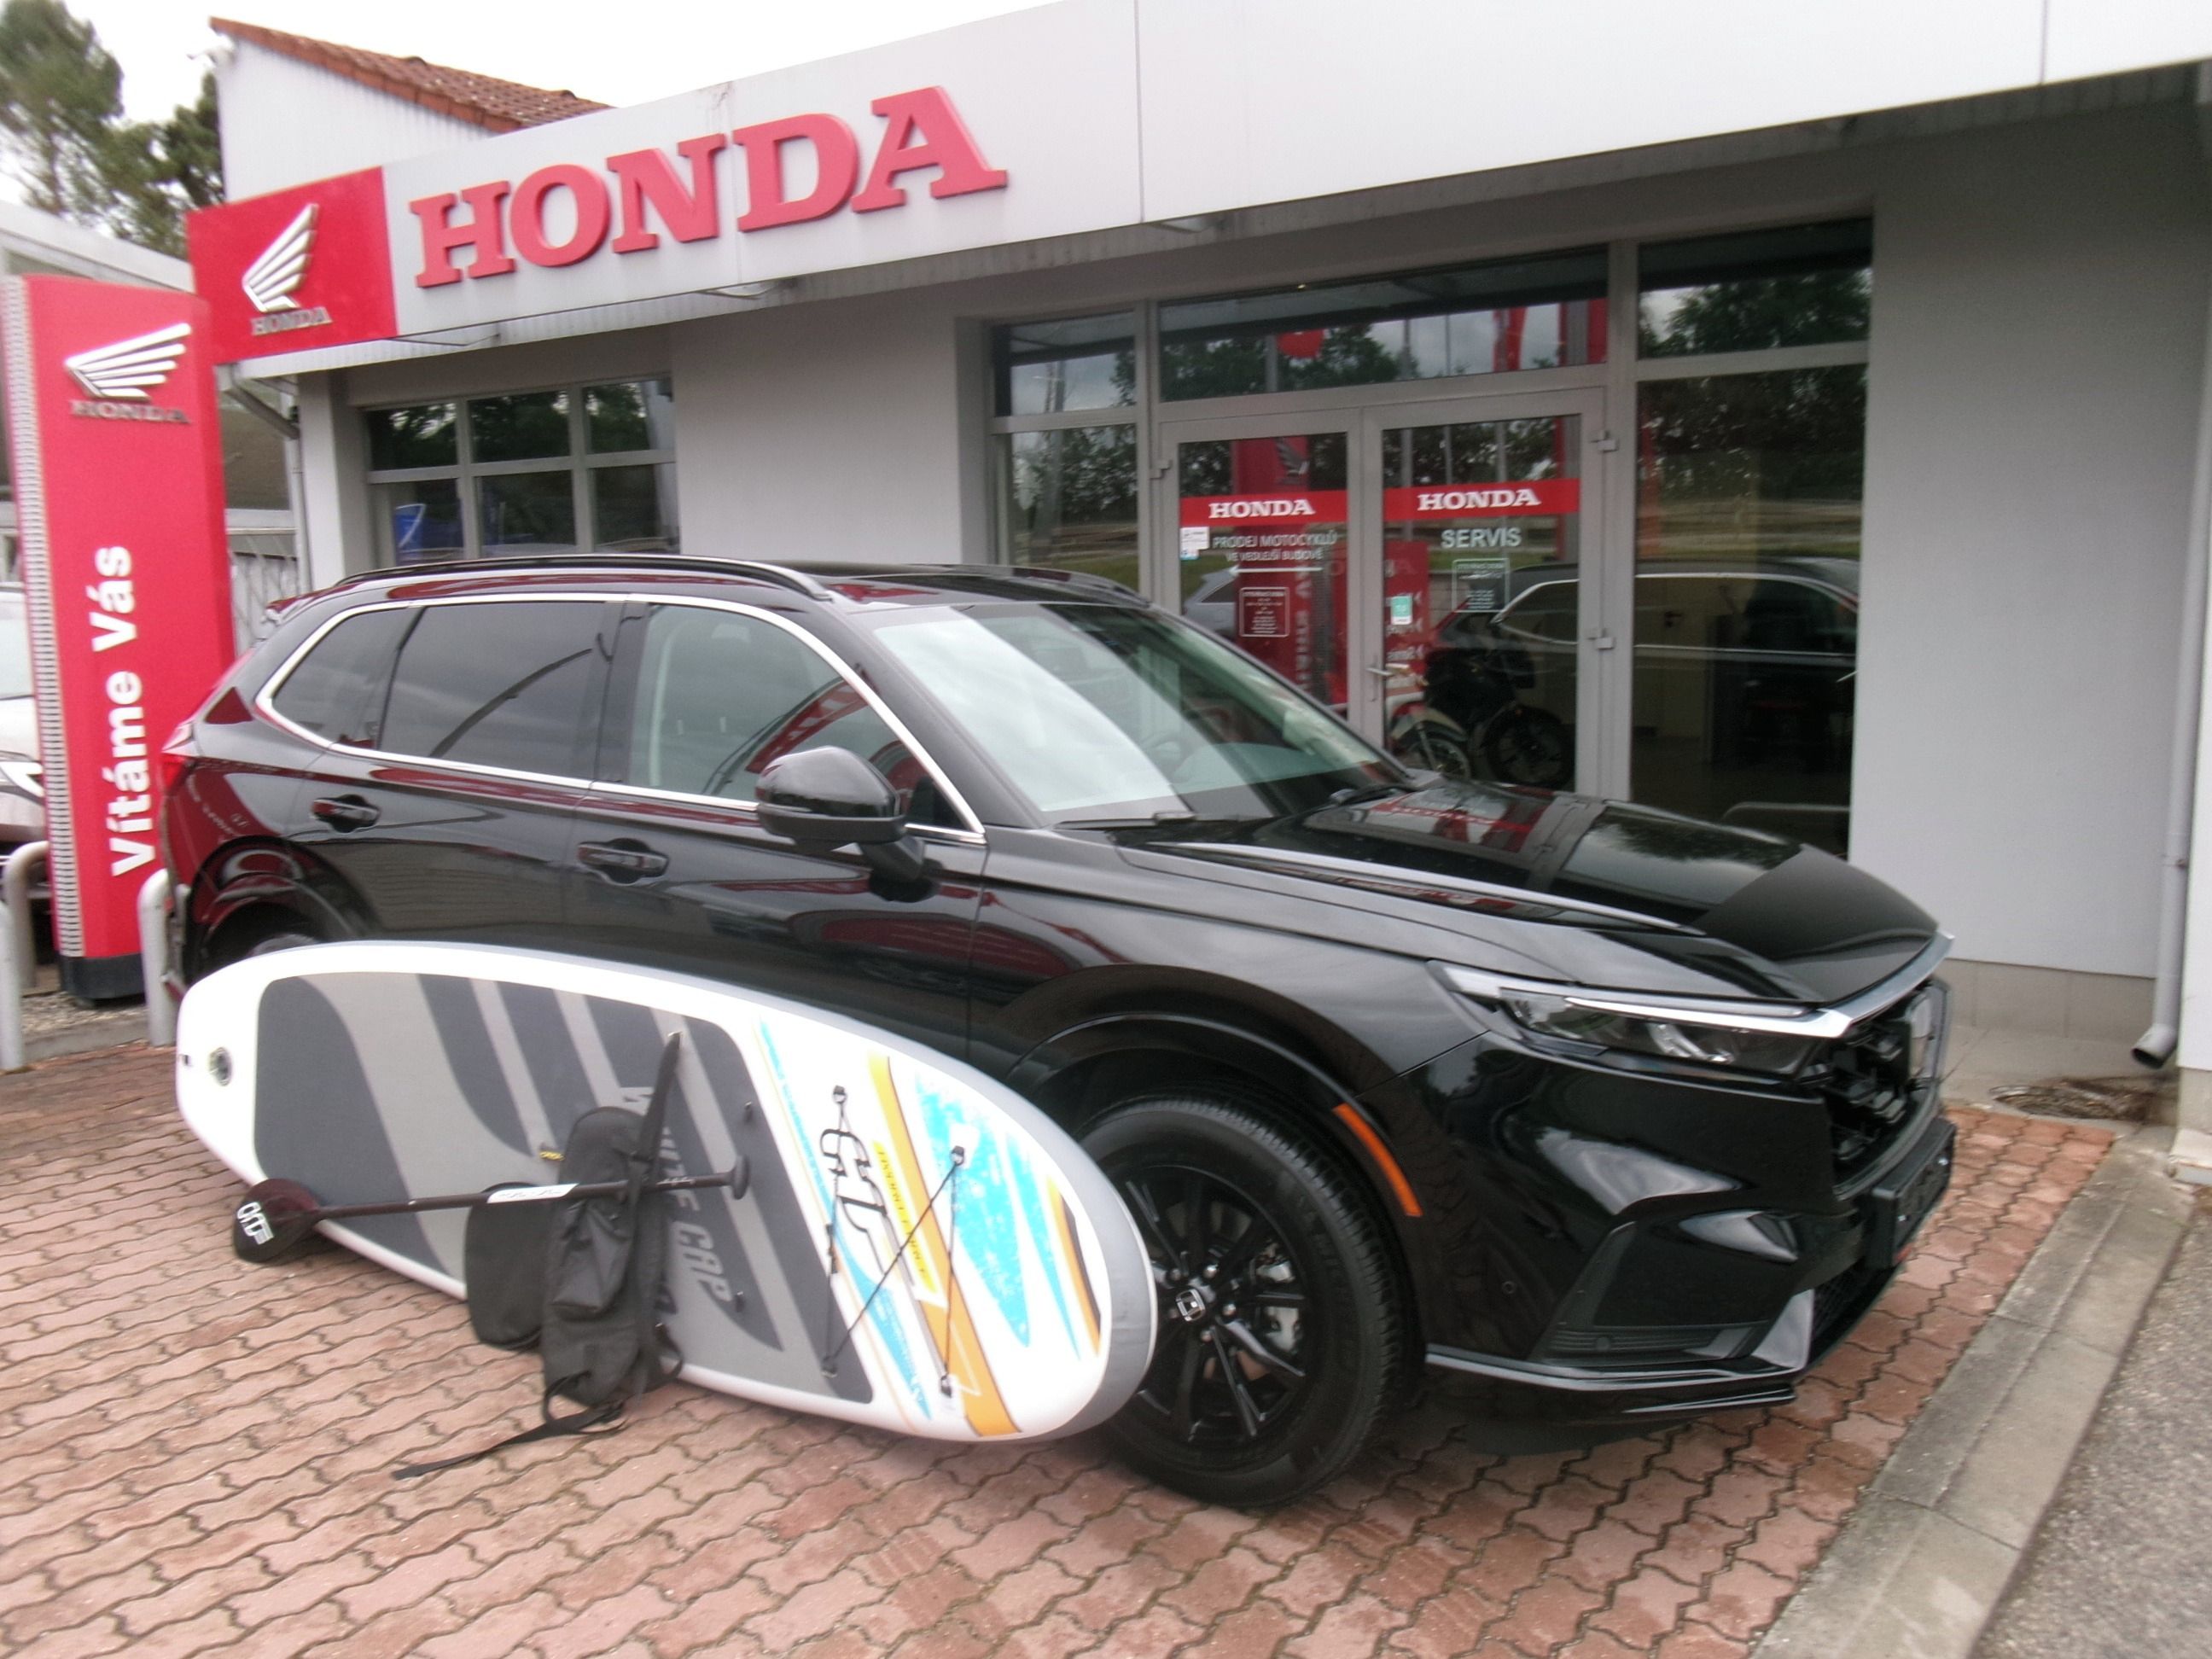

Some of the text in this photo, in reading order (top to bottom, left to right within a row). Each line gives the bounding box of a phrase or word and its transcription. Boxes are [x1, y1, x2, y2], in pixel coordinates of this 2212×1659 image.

[410, 85, 1008, 288] HONDA
[251, 306, 333, 336] HONDA
[70, 400, 190, 424] HONDA
[1208, 499, 1315, 518] HONDA
[1417, 487, 1542, 512] HONDA
[1441, 527, 1522, 549] SERVIS
[86, 545, 156, 877] Vítáme Vás
